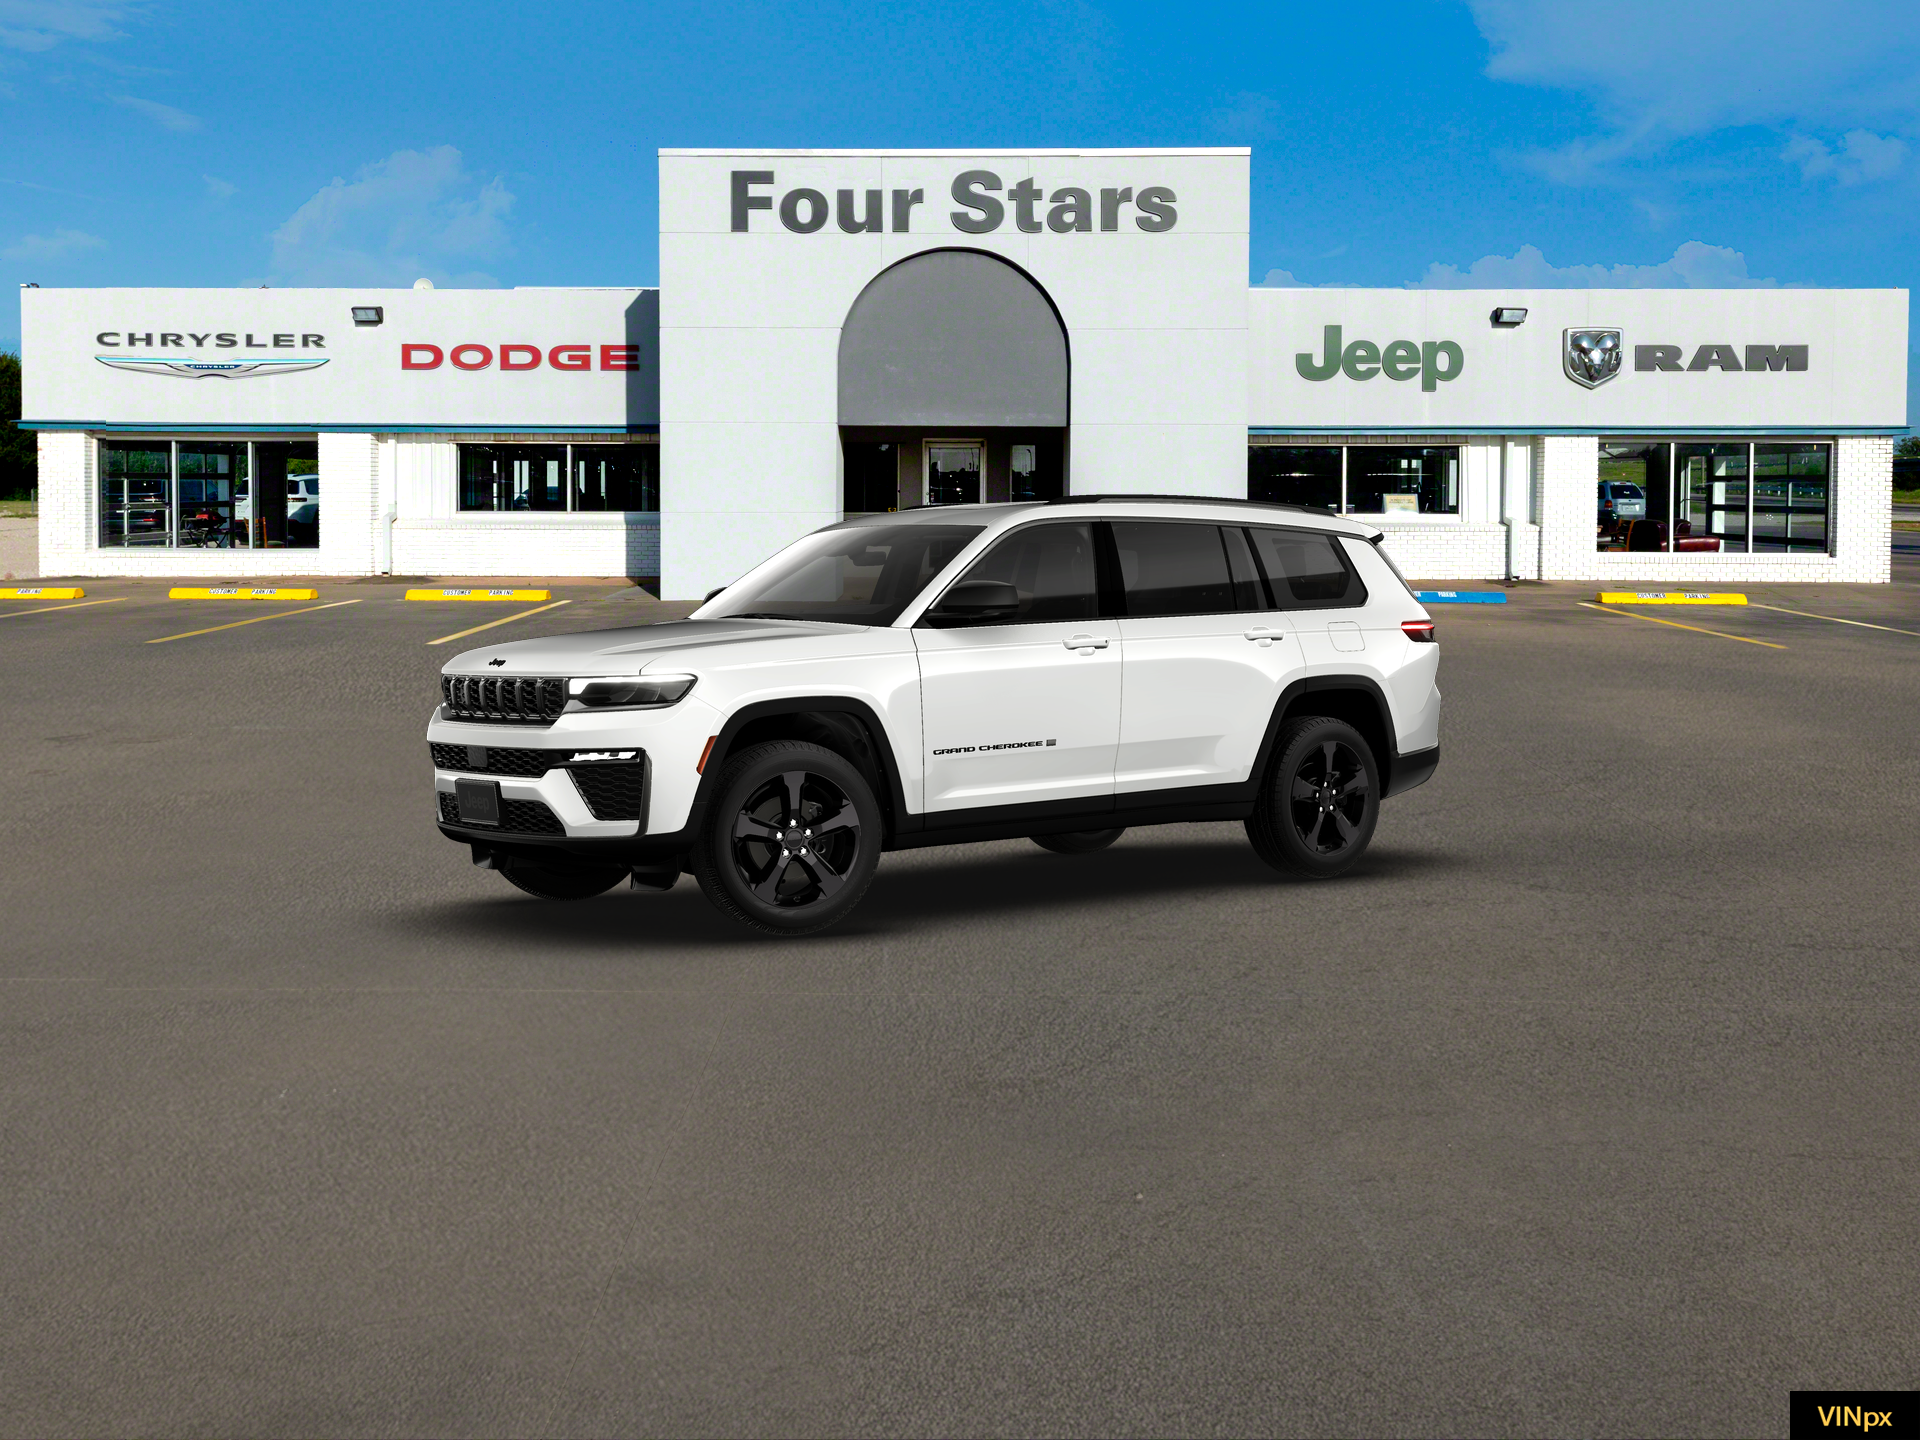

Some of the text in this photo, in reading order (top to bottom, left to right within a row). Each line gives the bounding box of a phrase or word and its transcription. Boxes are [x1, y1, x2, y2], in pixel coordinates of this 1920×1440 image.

[730, 169, 1178, 233] Four Stars
[96, 332, 326, 348] CHRYSLER
[401, 343, 640, 371] DODGE
[1295, 324, 1464, 392] Jeep
[1634, 344, 1809, 372] RAM
[933, 746, 975, 755] GRAND
[979, 740, 1043, 751] CHEROKEE
[464, 791, 490, 813] Jeep
